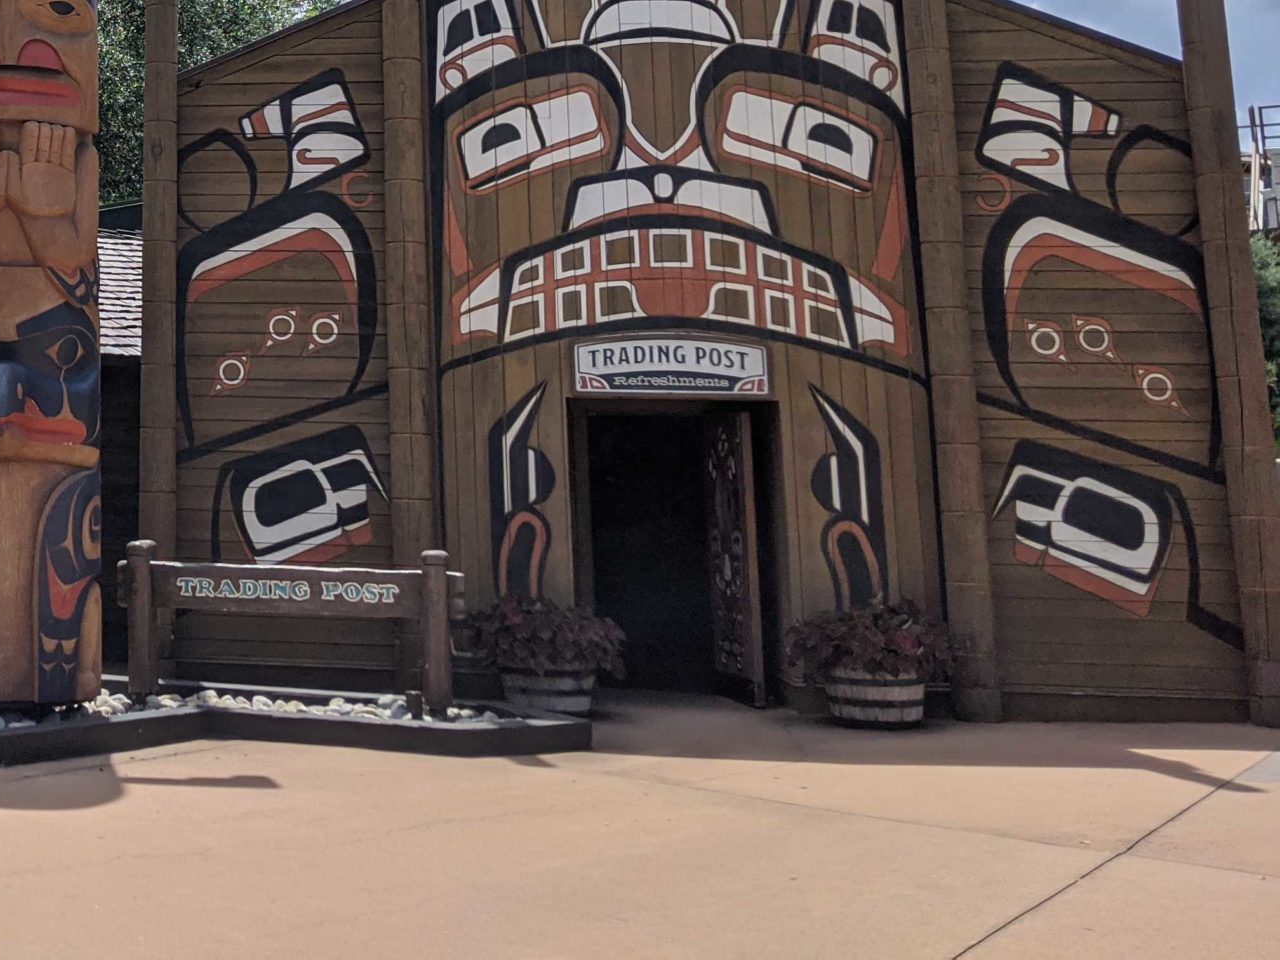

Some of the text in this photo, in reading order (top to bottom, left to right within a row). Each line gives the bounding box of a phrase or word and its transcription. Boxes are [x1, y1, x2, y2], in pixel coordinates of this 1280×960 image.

[587, 345, 749, 370] TRADING POST
[613, 375, 729, 388] Refreshments
[177, 577, 399, 603] TRADING POST
